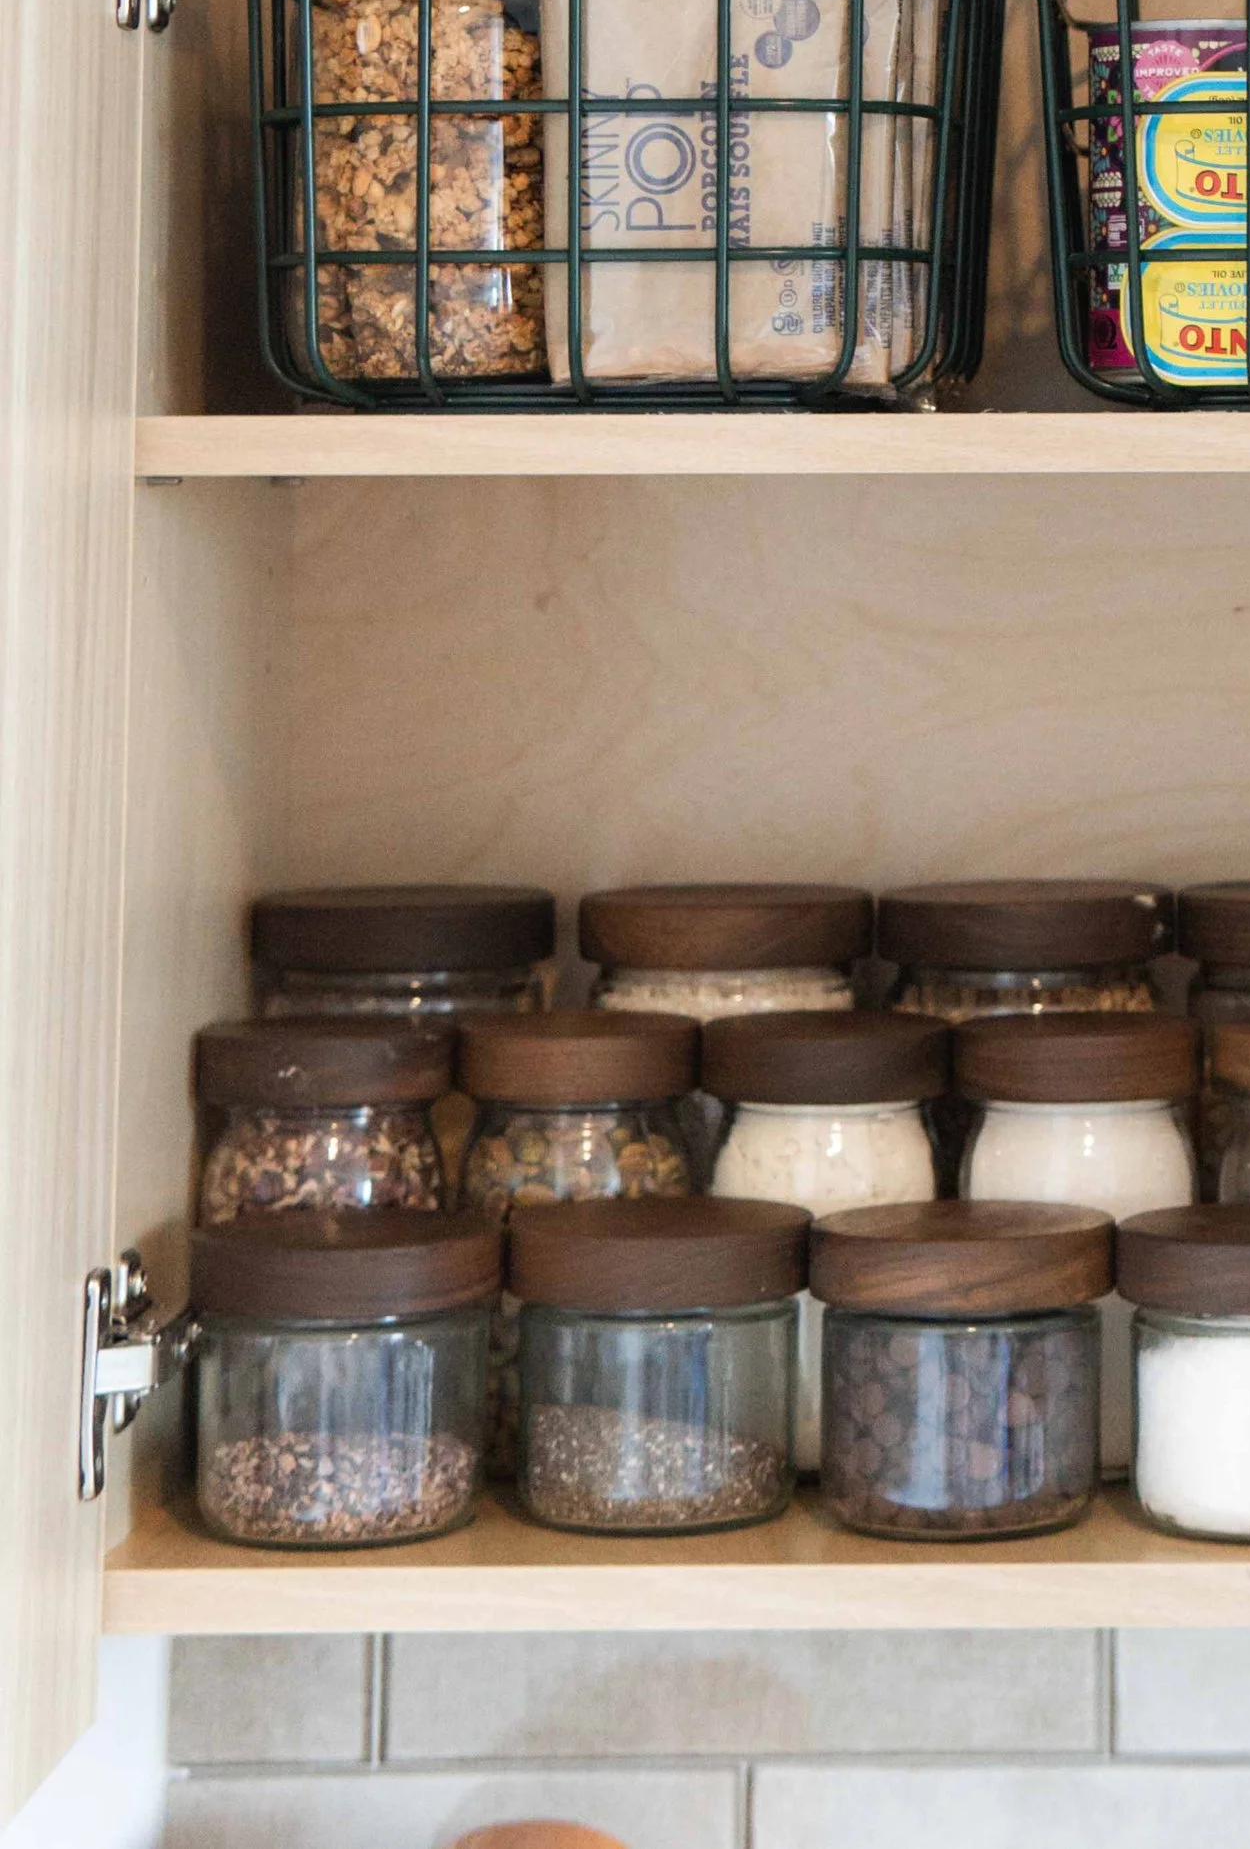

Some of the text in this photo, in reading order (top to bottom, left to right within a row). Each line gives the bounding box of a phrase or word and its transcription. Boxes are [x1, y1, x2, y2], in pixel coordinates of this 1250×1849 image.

[1149, 44, 1184, 57] TASTE
[1134, 67, 1201, 78] IMPROVED
[1228, 116, 1244, 125] OIL
[581, 88, 621, 232] SKINNY
[701, 81, 719, 232] POPCORN
[1211, 270, 1228, 279] OIL
[812, 285, 823, 334] CHILDREN
